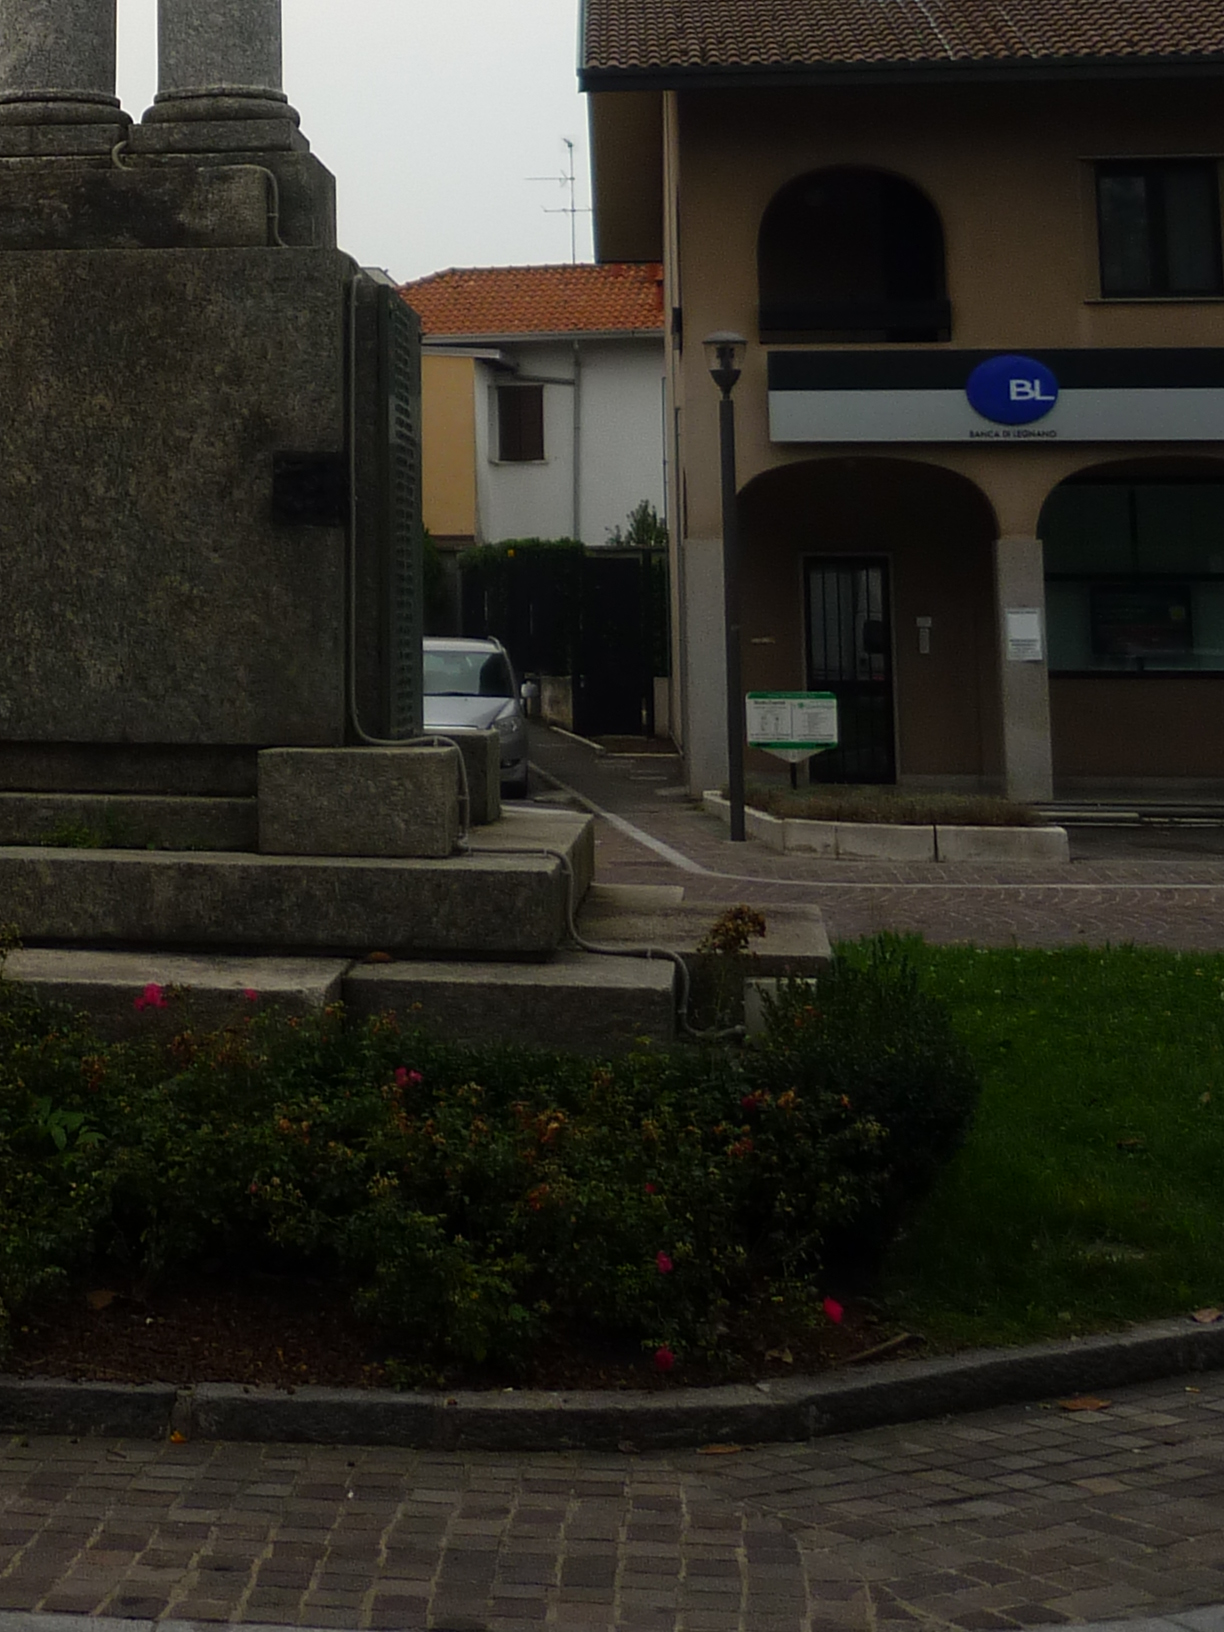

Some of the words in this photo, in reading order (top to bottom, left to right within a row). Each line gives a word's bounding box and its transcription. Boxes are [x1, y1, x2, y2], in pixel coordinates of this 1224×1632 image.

[1009, 379, 1056, 401] BL
[969, 430, 1000, 438] BANCA
[1002, 430, 1011, 438] DI
[1012, 430, 1057, 438] LEGNANO
